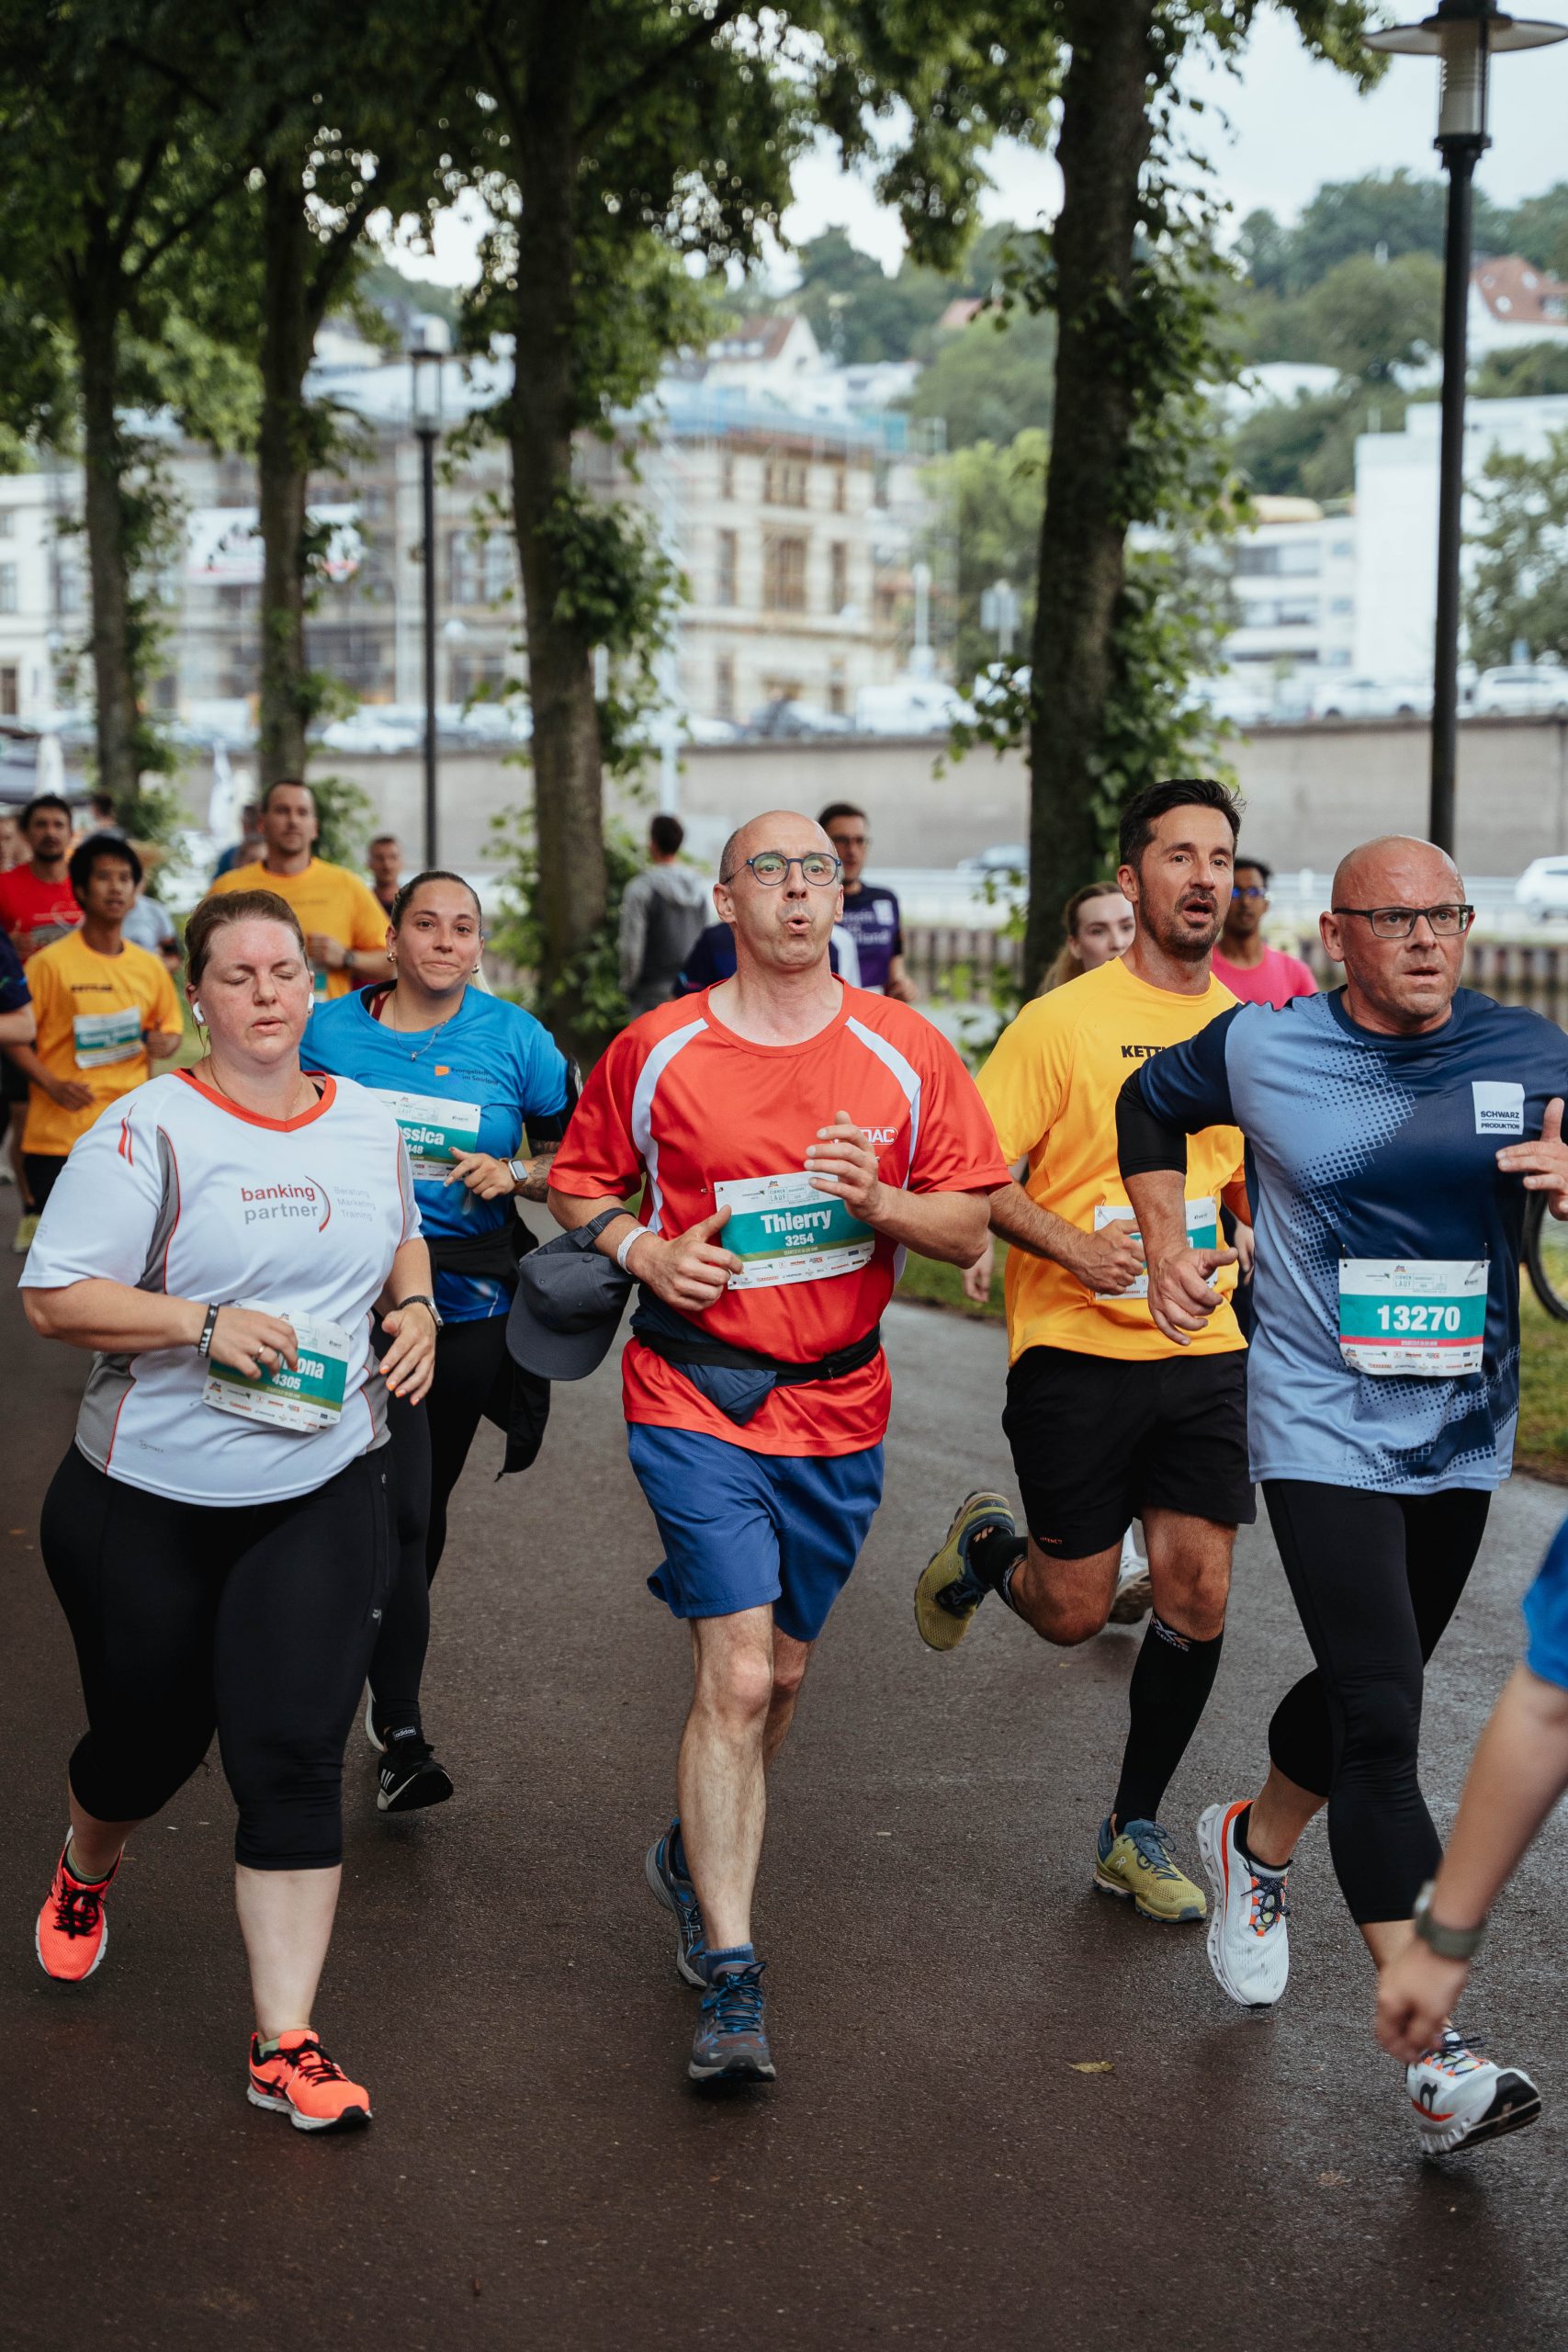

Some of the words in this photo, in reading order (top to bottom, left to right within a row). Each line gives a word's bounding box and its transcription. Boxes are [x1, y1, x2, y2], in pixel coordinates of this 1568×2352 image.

[1121, 1045, 1166, 1057] KETT
[1480, 1110, 1520, 1119] SCHWARZ
[241, 1183, 316, 1203] banking
[333, 1186, 370, 1199] Beratung
[337, 1198, 377, 1211] Marketing
[244, 1203, 319, 1225] partner
[341, 1209, 373, 1222] Training
[761, 1209, 832, 1234] Thierry
[784, 1232, 815, 1247] 3254
[1377, 1305, 1461, 1332] 13270
[272, 1374, 302, 1390] 4305
